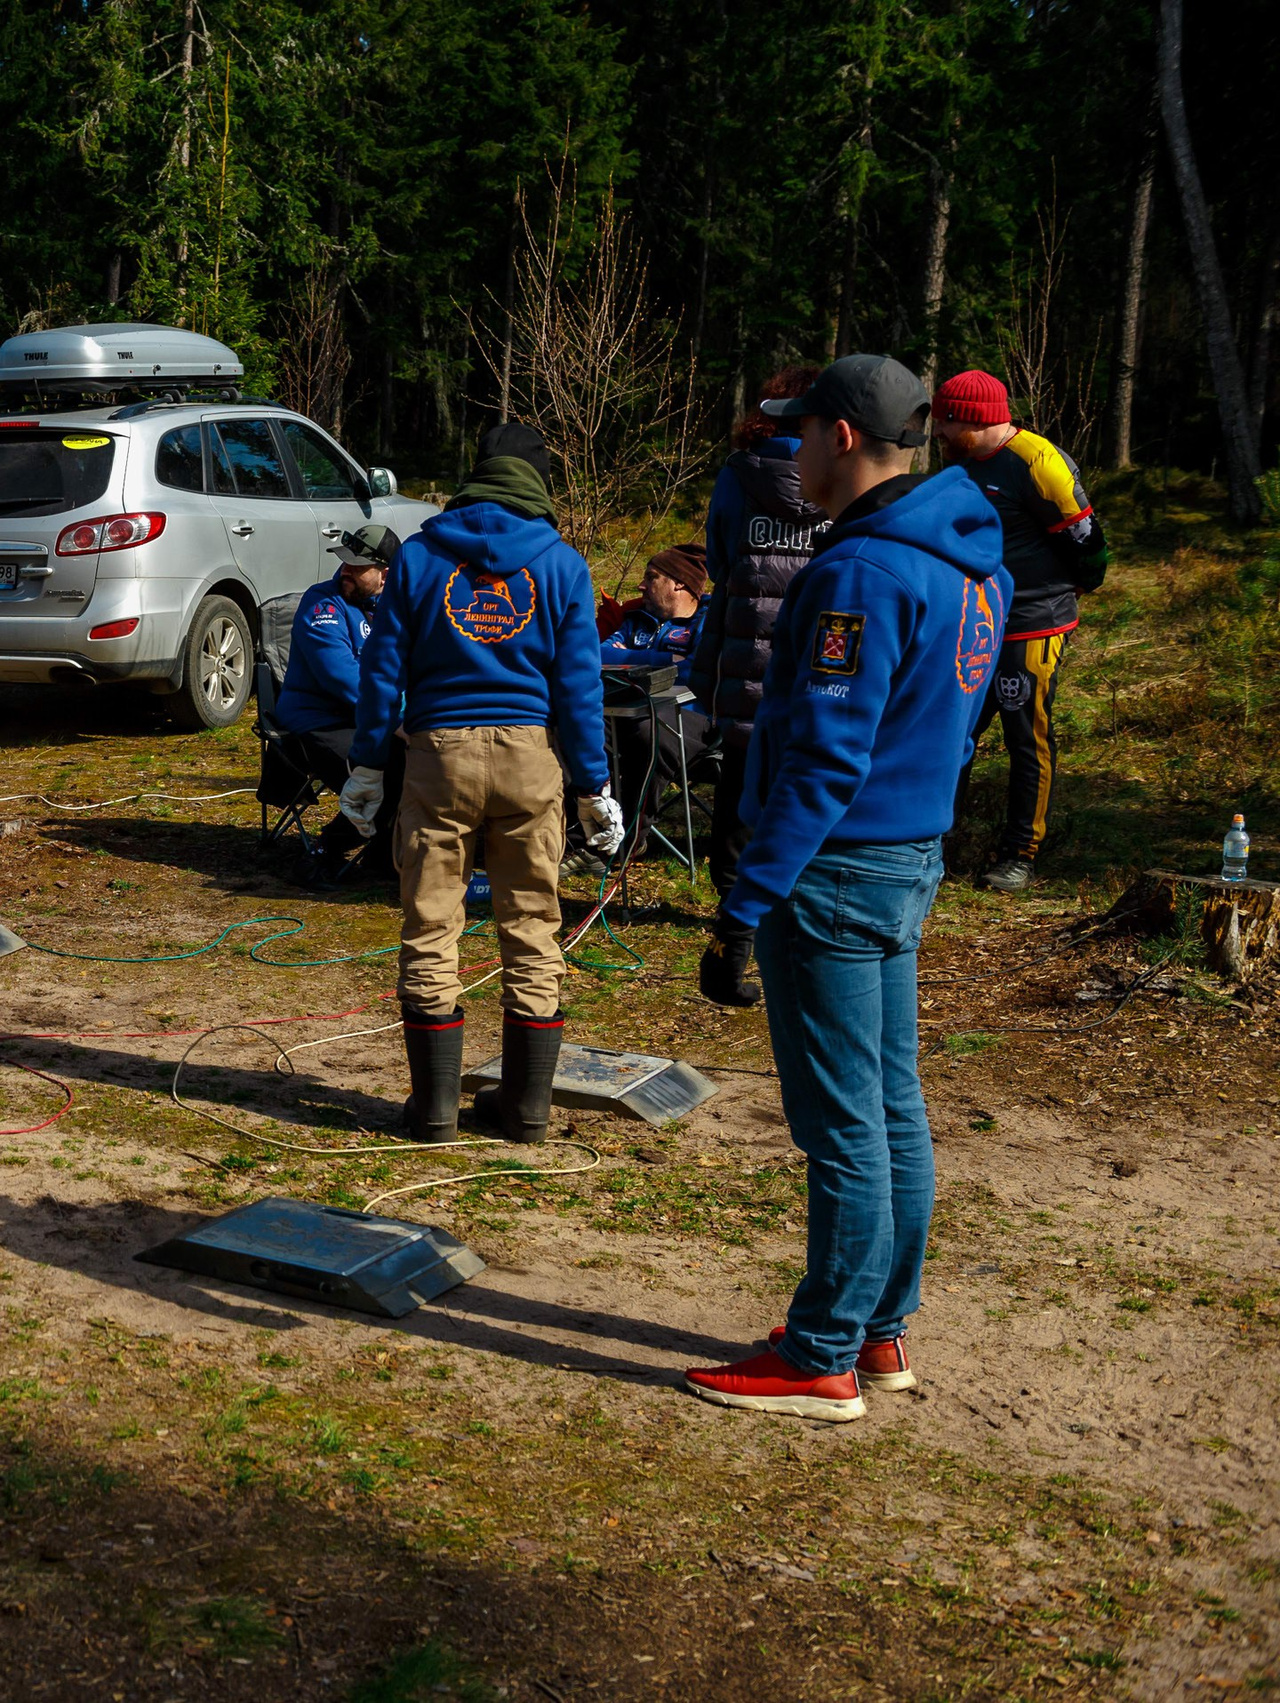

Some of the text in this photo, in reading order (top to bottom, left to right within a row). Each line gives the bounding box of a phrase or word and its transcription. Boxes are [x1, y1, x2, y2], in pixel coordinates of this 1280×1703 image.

[24, 352, 49, 360] THULE
[117, 351, 134, 360] THULE
[464, 613, 515, 625] ЛЕНИНГРАД
[474, 624, 503, 634] ТРОФИ
